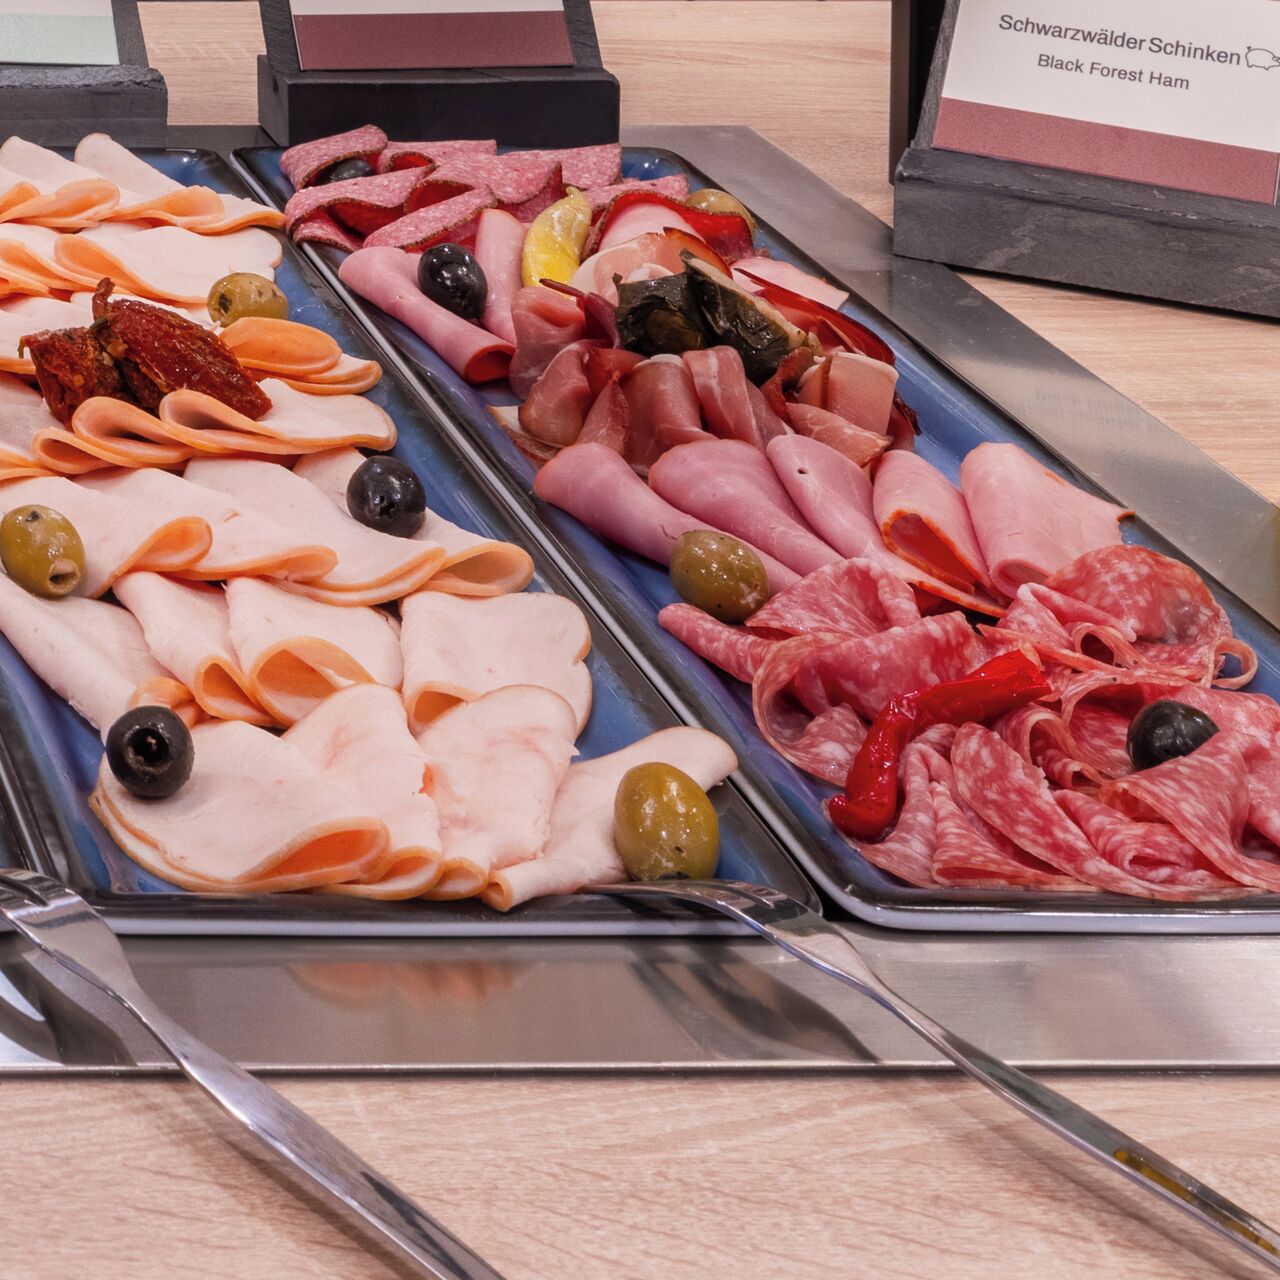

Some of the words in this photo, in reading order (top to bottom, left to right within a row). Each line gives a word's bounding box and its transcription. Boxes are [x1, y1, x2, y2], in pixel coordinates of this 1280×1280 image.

[999, 15, 1146, 50] Schwarzwälder
[1149, 37, 1240, 65] Schinken
[1038, 54, 1084, 73] Black
[1090, 62, 1143, 82] Forest
[1149, 71, 1189, 89] Ham
